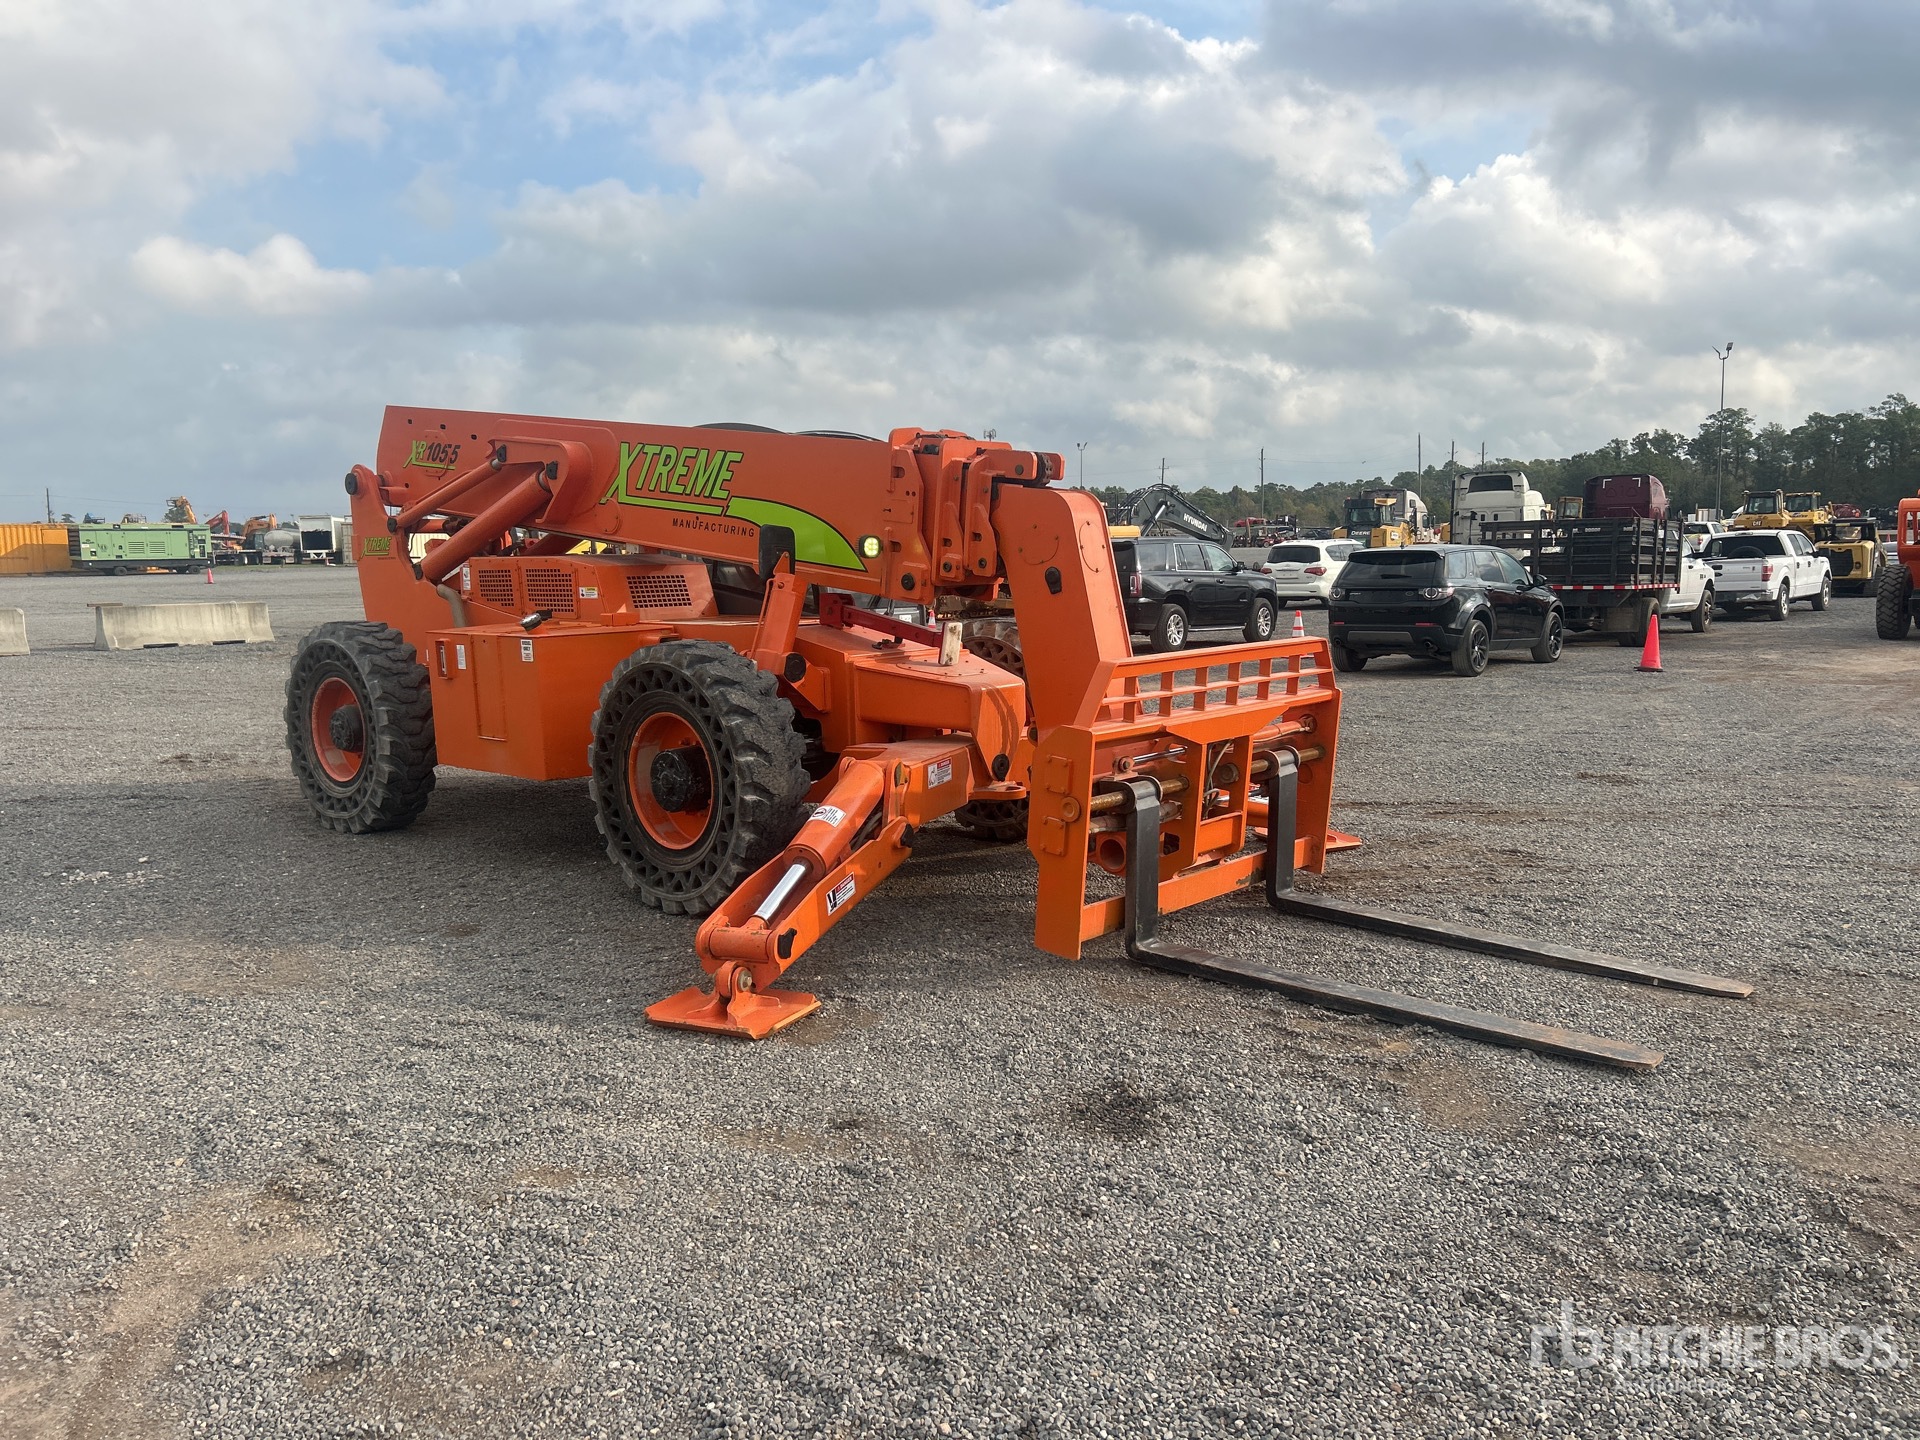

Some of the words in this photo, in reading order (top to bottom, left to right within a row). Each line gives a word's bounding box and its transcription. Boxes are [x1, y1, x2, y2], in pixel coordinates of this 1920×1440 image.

[599, 442, 744, 505] XTREME
[672, 518, 755, 537] MANUFACTURING
[1183, 512, 1208, 532] HYUNDAI
[360, 536, 392, 559] XTREME
